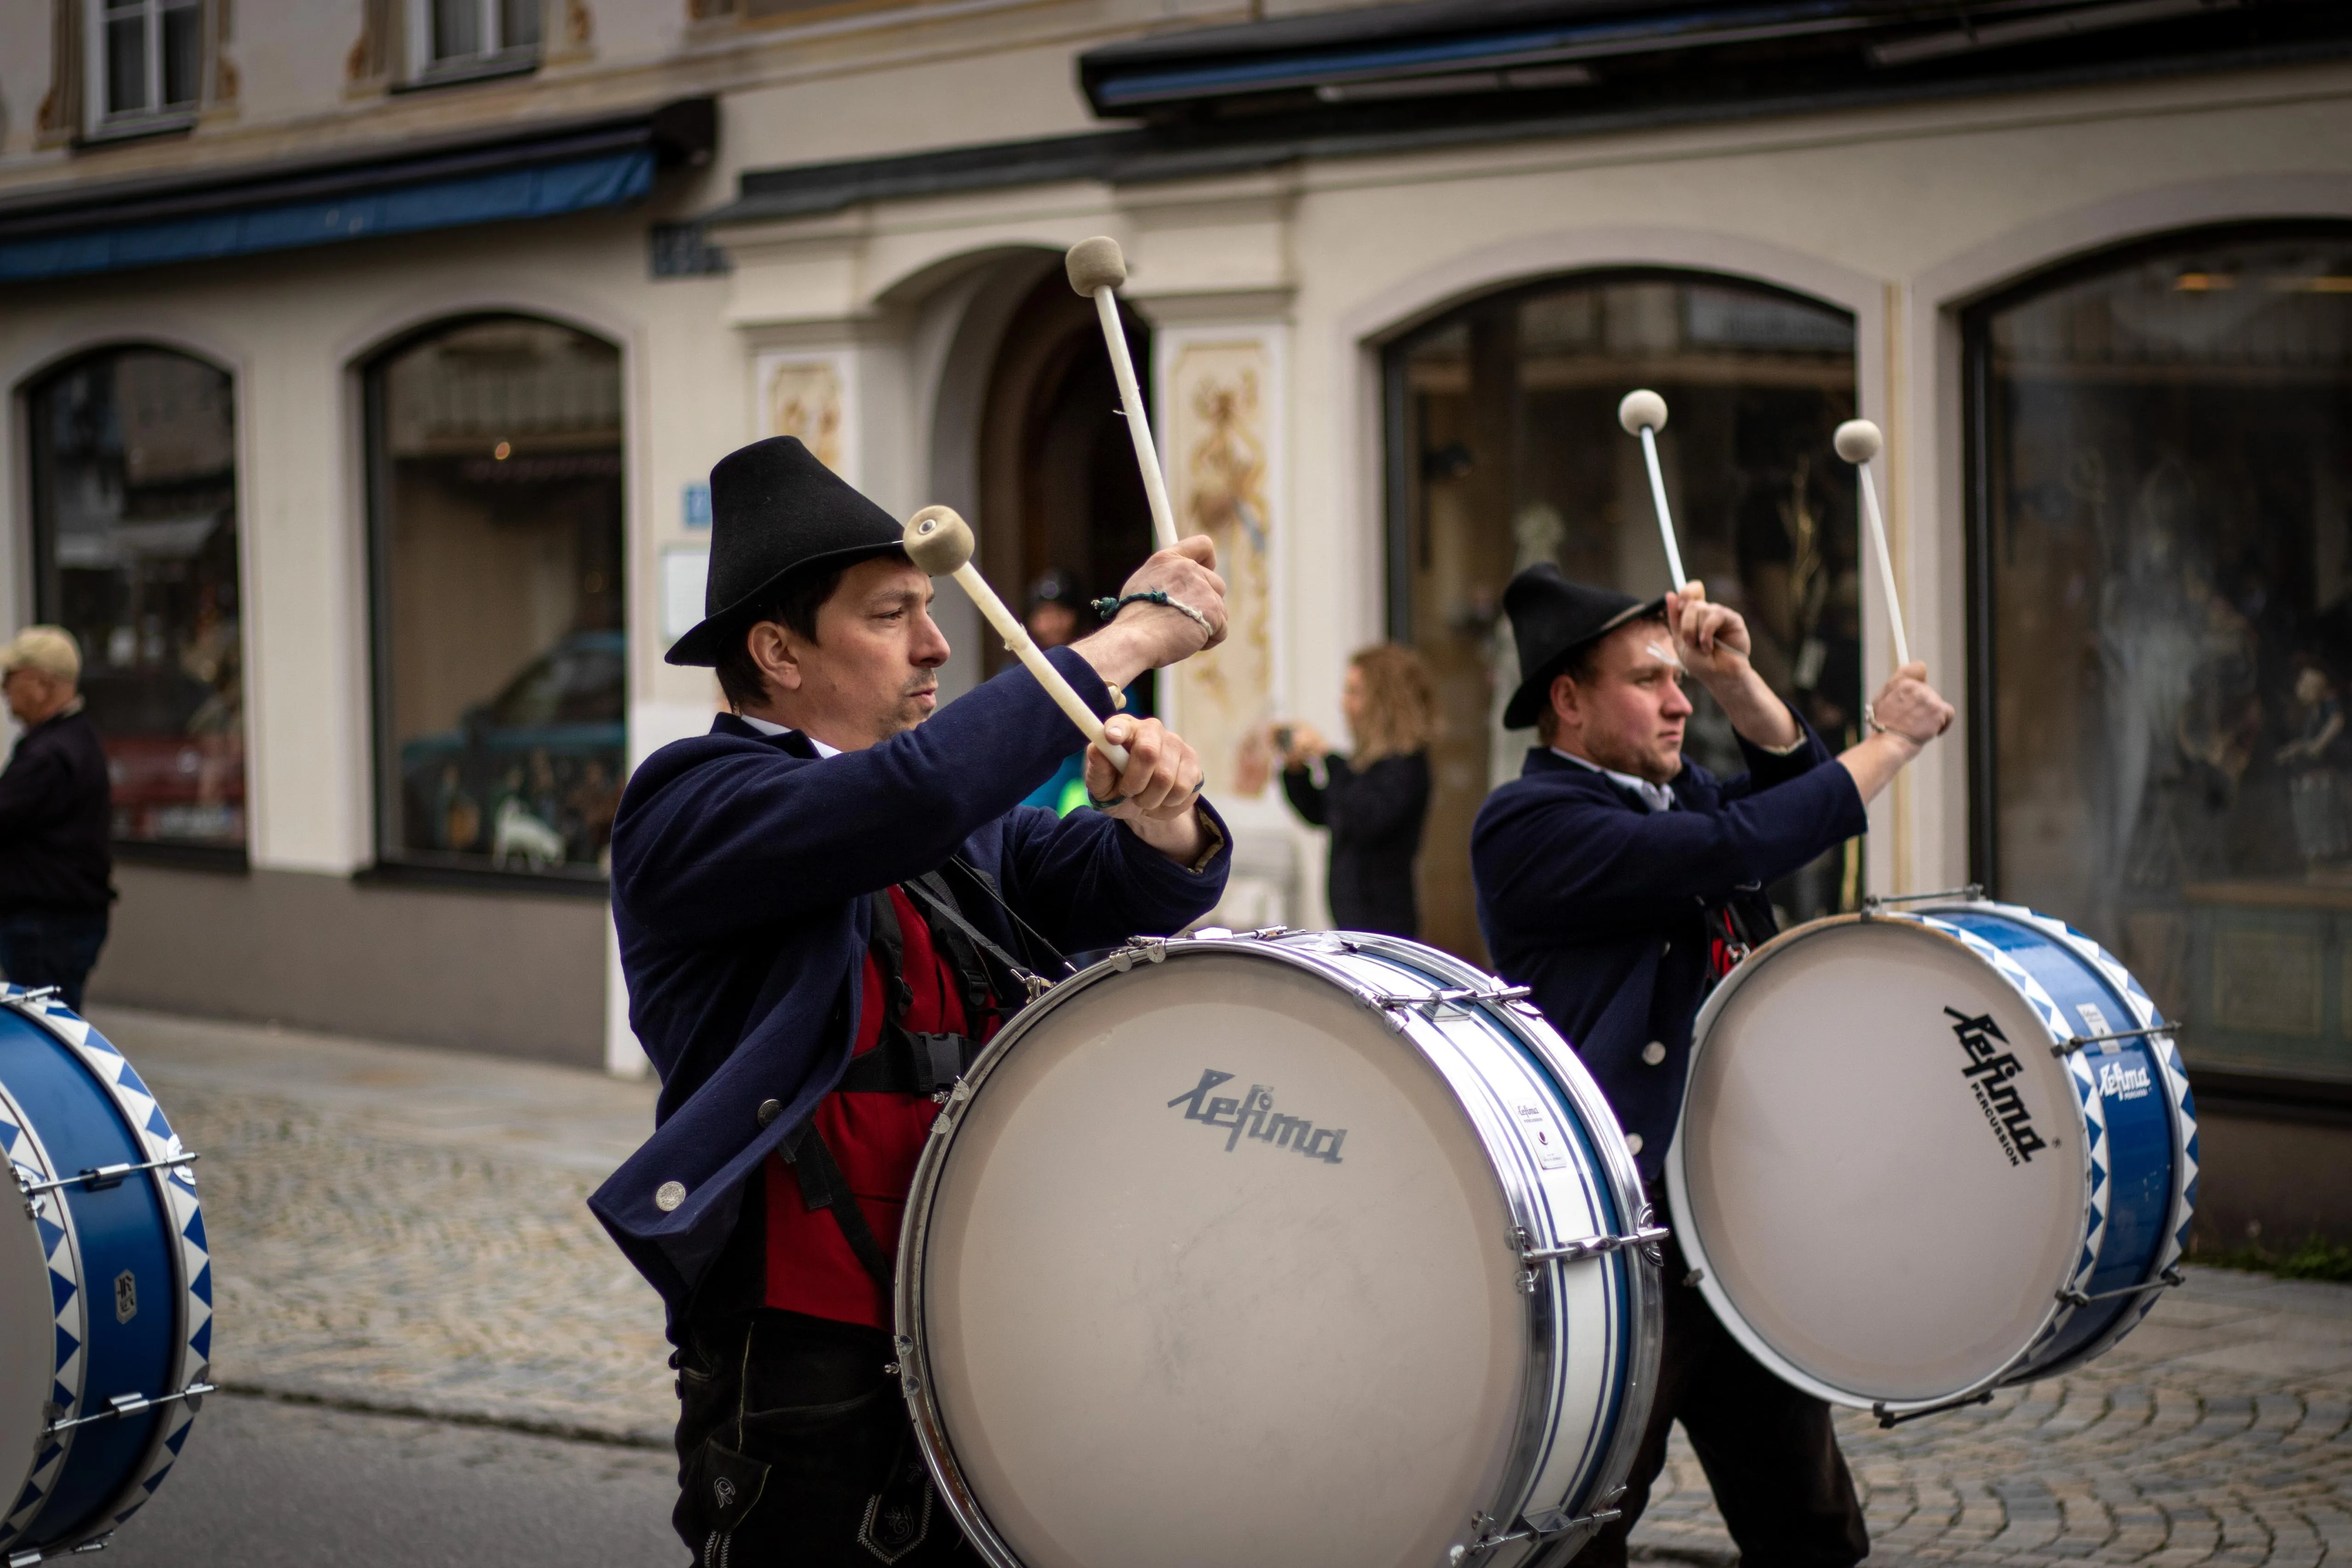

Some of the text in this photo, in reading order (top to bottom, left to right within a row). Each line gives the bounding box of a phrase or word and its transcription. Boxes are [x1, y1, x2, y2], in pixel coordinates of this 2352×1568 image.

[1167, 1068, 1348, 1164] Lefima
[1944, 1005, 2047, 1163] Lefima
[1971, 1082, 2020, 1167] PERCUSSION
[2099, 1061, 2151, 1102] Lefima
